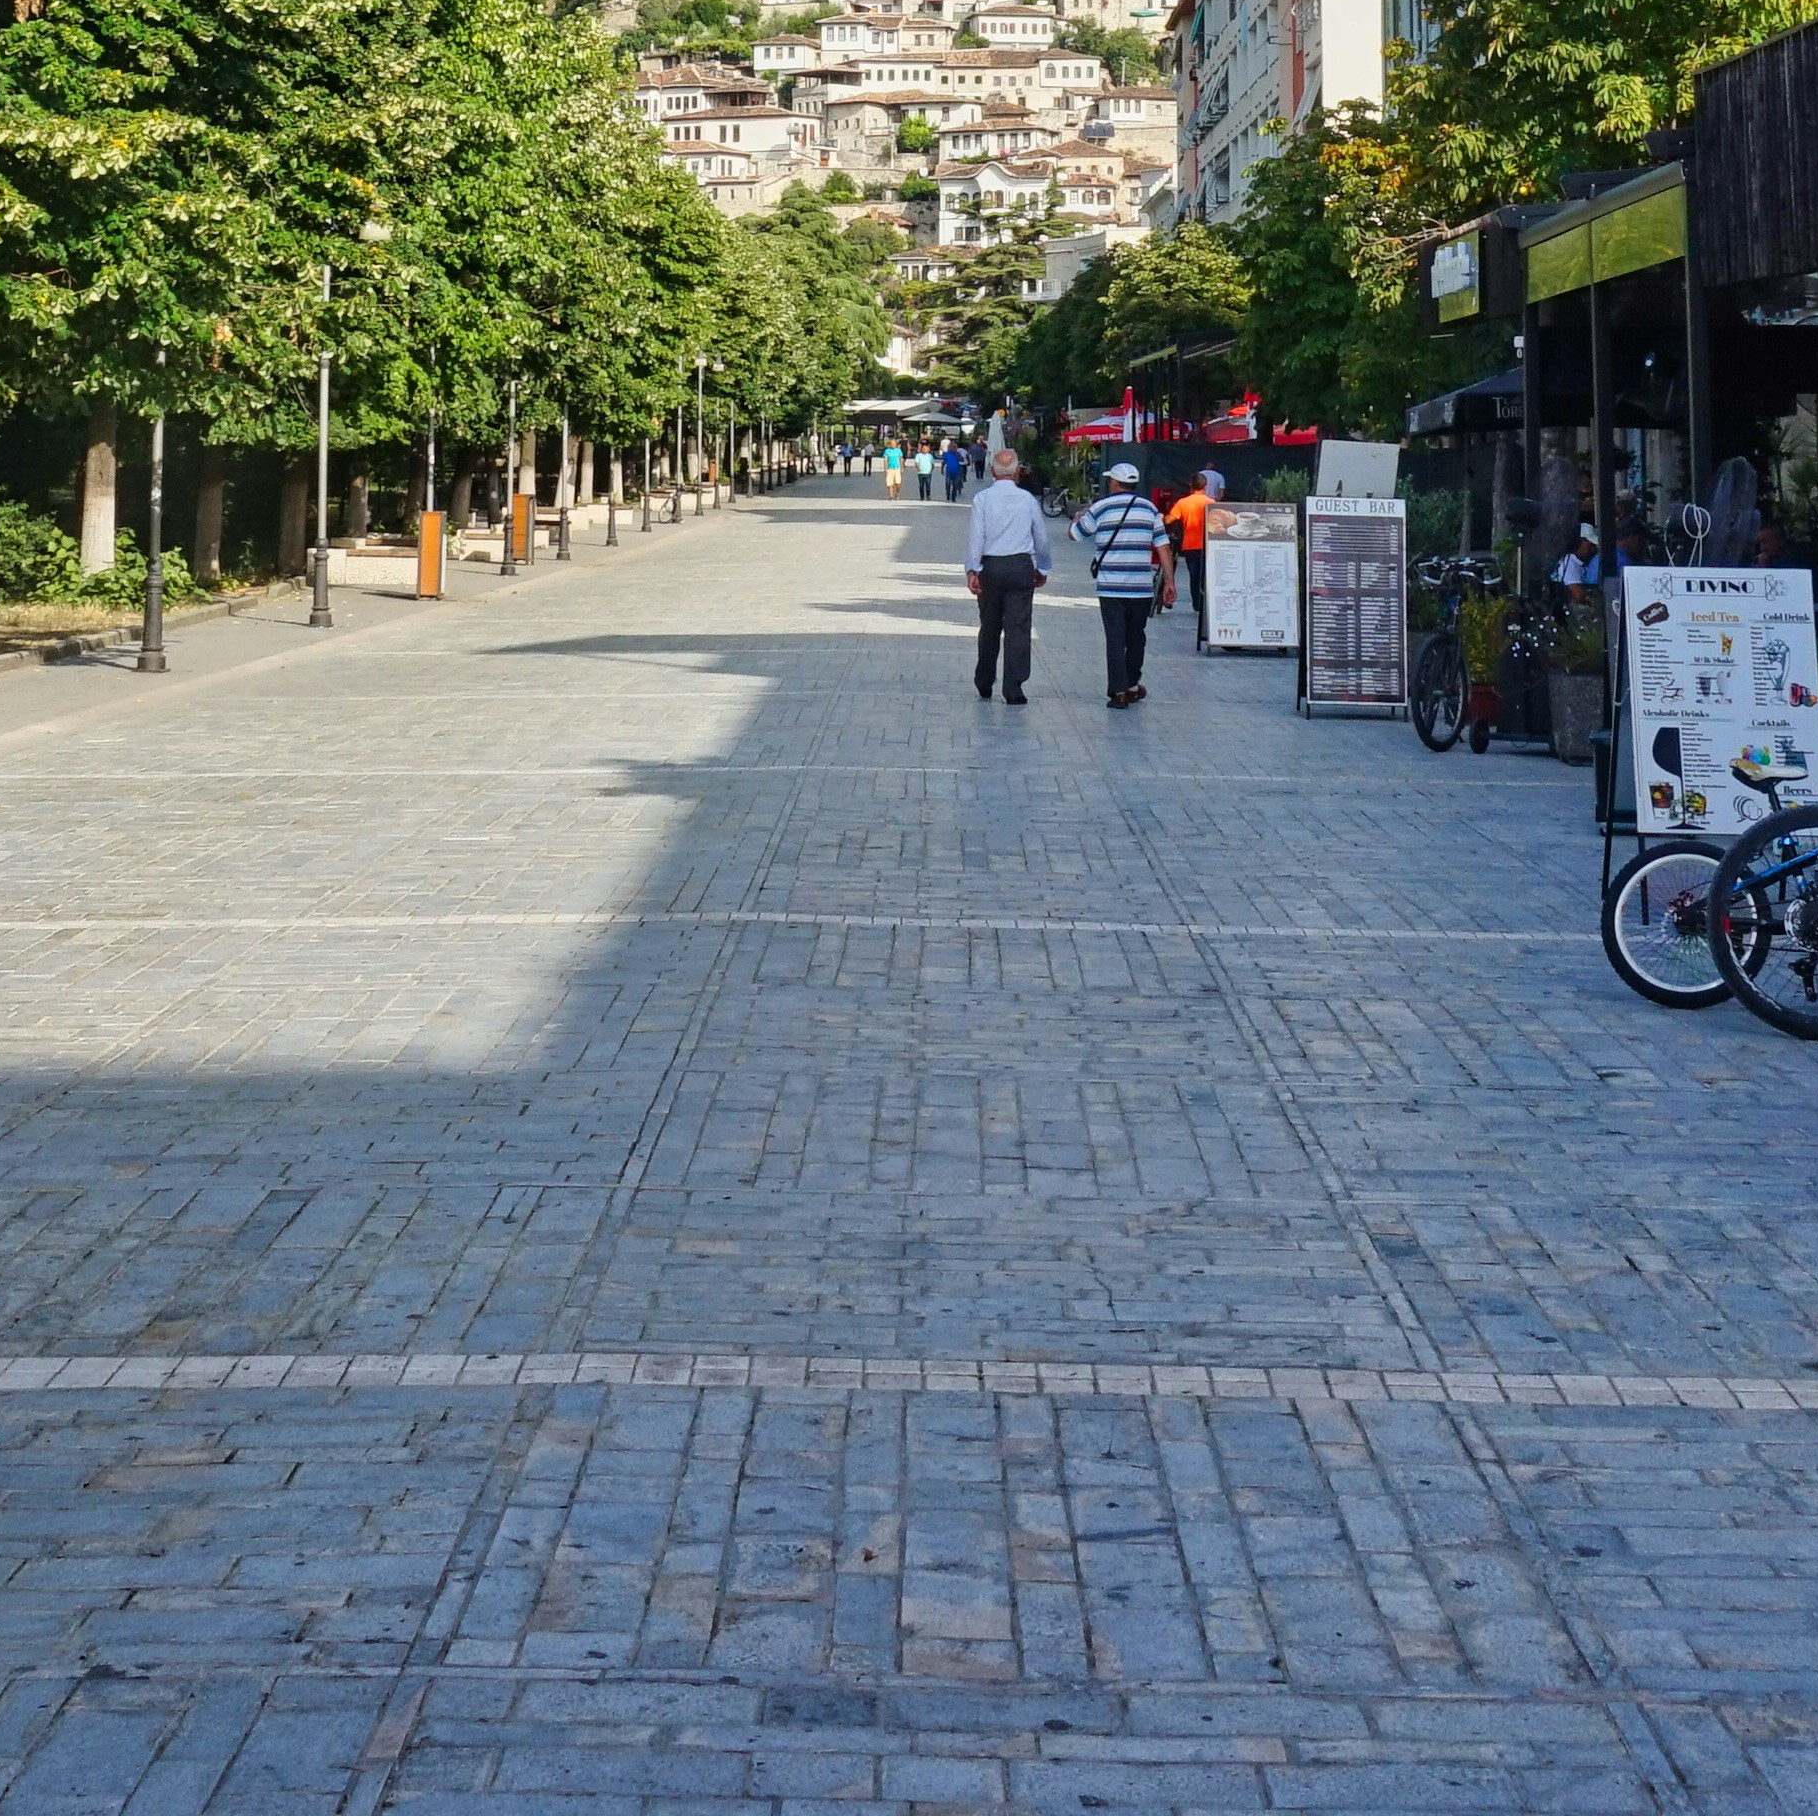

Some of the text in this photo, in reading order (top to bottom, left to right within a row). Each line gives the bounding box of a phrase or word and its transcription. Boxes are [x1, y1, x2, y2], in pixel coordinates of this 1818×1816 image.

[1315, 500, 1396, 514] GUEST BAR
[1686, 580, 1755, 594] DIVINO
[1691, 612, 1739, 622] Iced Tea
[1784, 613, 1810, 621] Drink
[1641, 709, 1710, 718] Alcoholic Drinks
[1752, 719, 1791, 727] Cocktails
[1783, 786, 1813, 795] Beers
